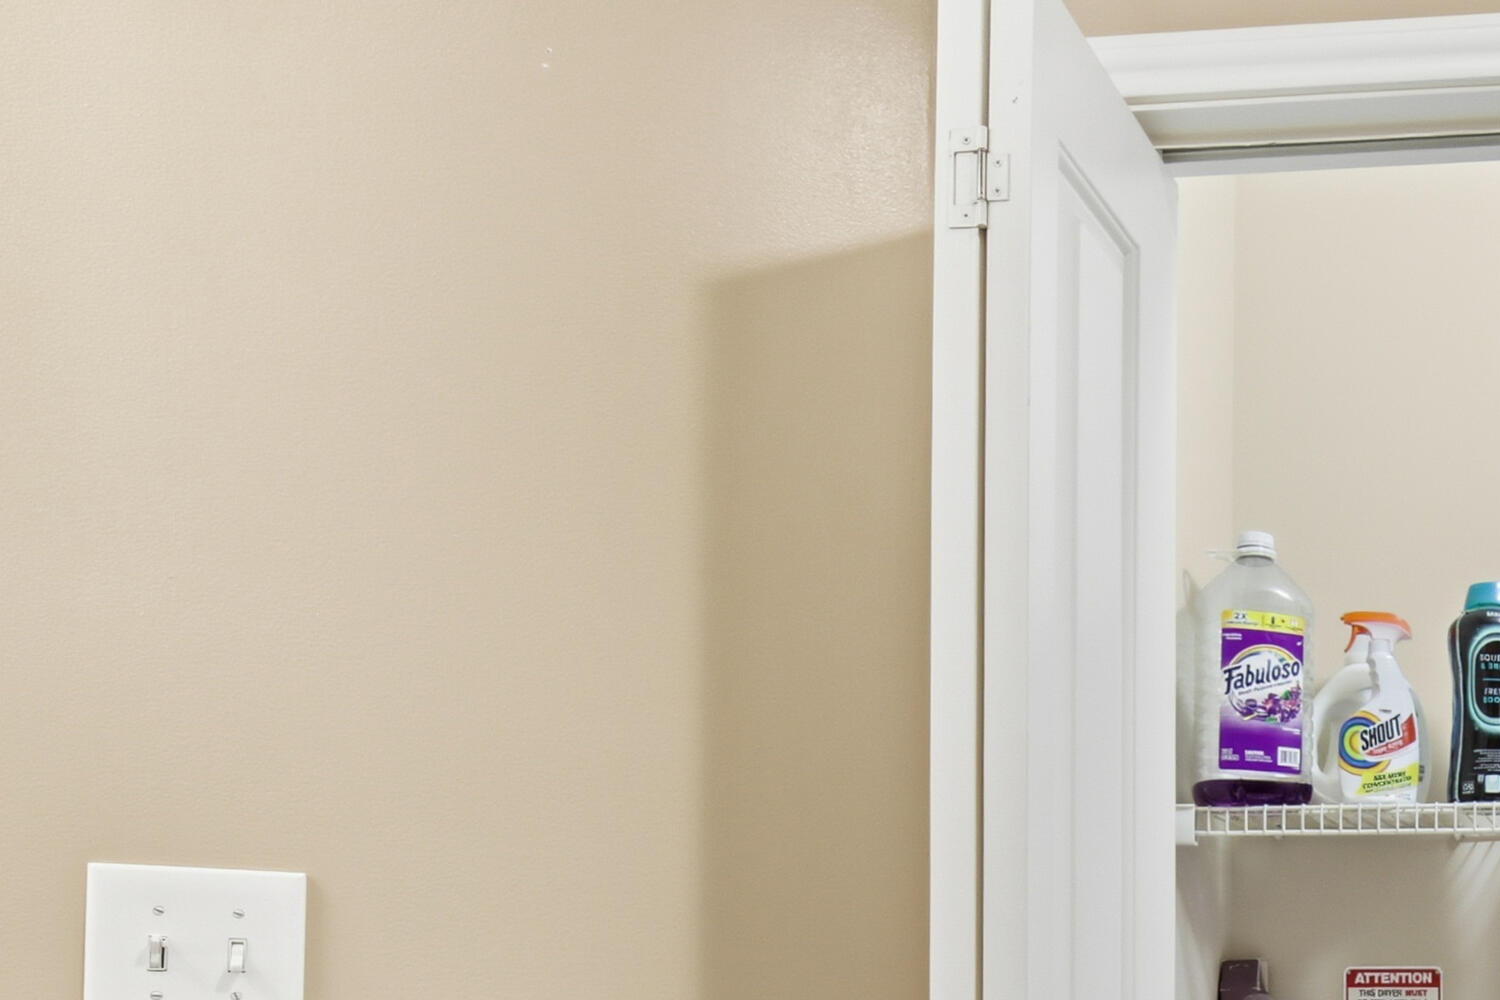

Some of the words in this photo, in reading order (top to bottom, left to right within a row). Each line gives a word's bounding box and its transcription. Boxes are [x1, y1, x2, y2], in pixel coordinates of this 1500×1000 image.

[1223, 660, 1300, 695] Fabuloso
[1361, 713, 1401, 751] SHOUT
[1354, 972, 1433, 984] ATTENTION
[1358, 989, 1376, 997] THIS
[1377, 989, 1402, 997] DRYER
[1405, 989, 1428, 997] MUST
